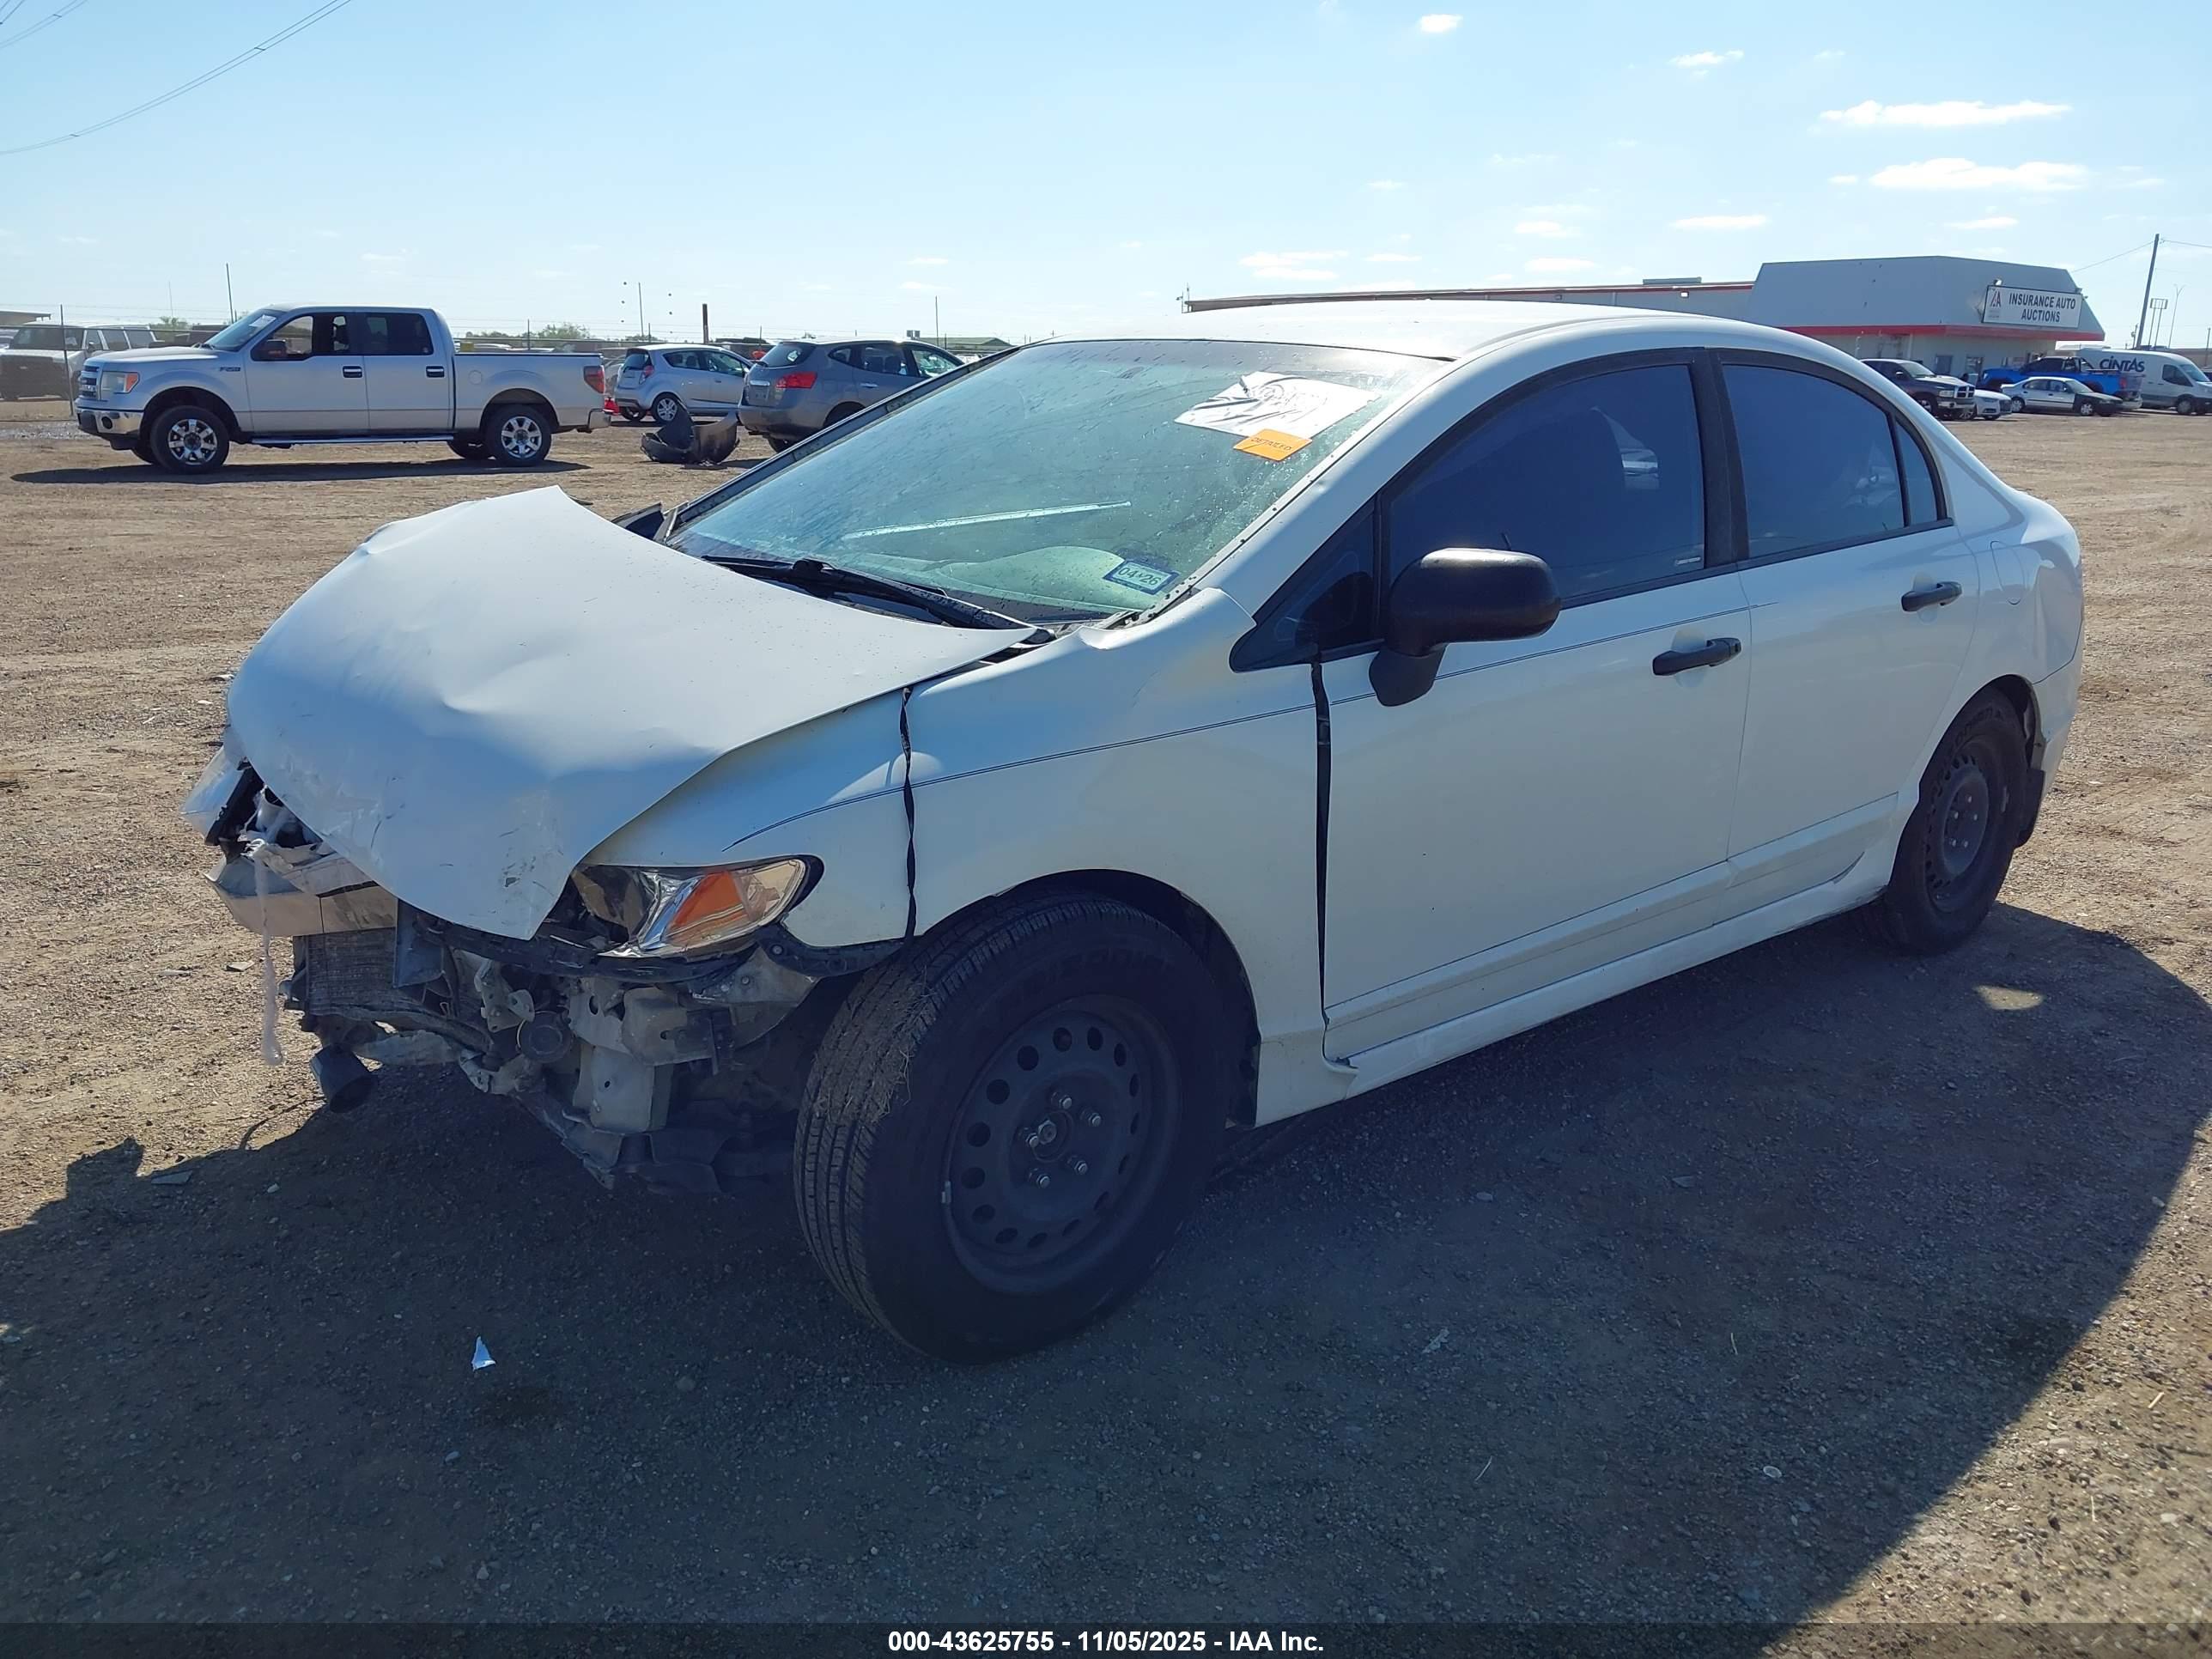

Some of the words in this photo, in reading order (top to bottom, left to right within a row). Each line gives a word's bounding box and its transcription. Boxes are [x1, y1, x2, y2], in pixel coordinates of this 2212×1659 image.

[2008, 292, 2055, 308] INSURANCE
[2056, 297, 2076, 310] AUTO
[2021, 308, 2061, 323] AUCTIONS
[1250, 437, 1292, 451] DETAILED
